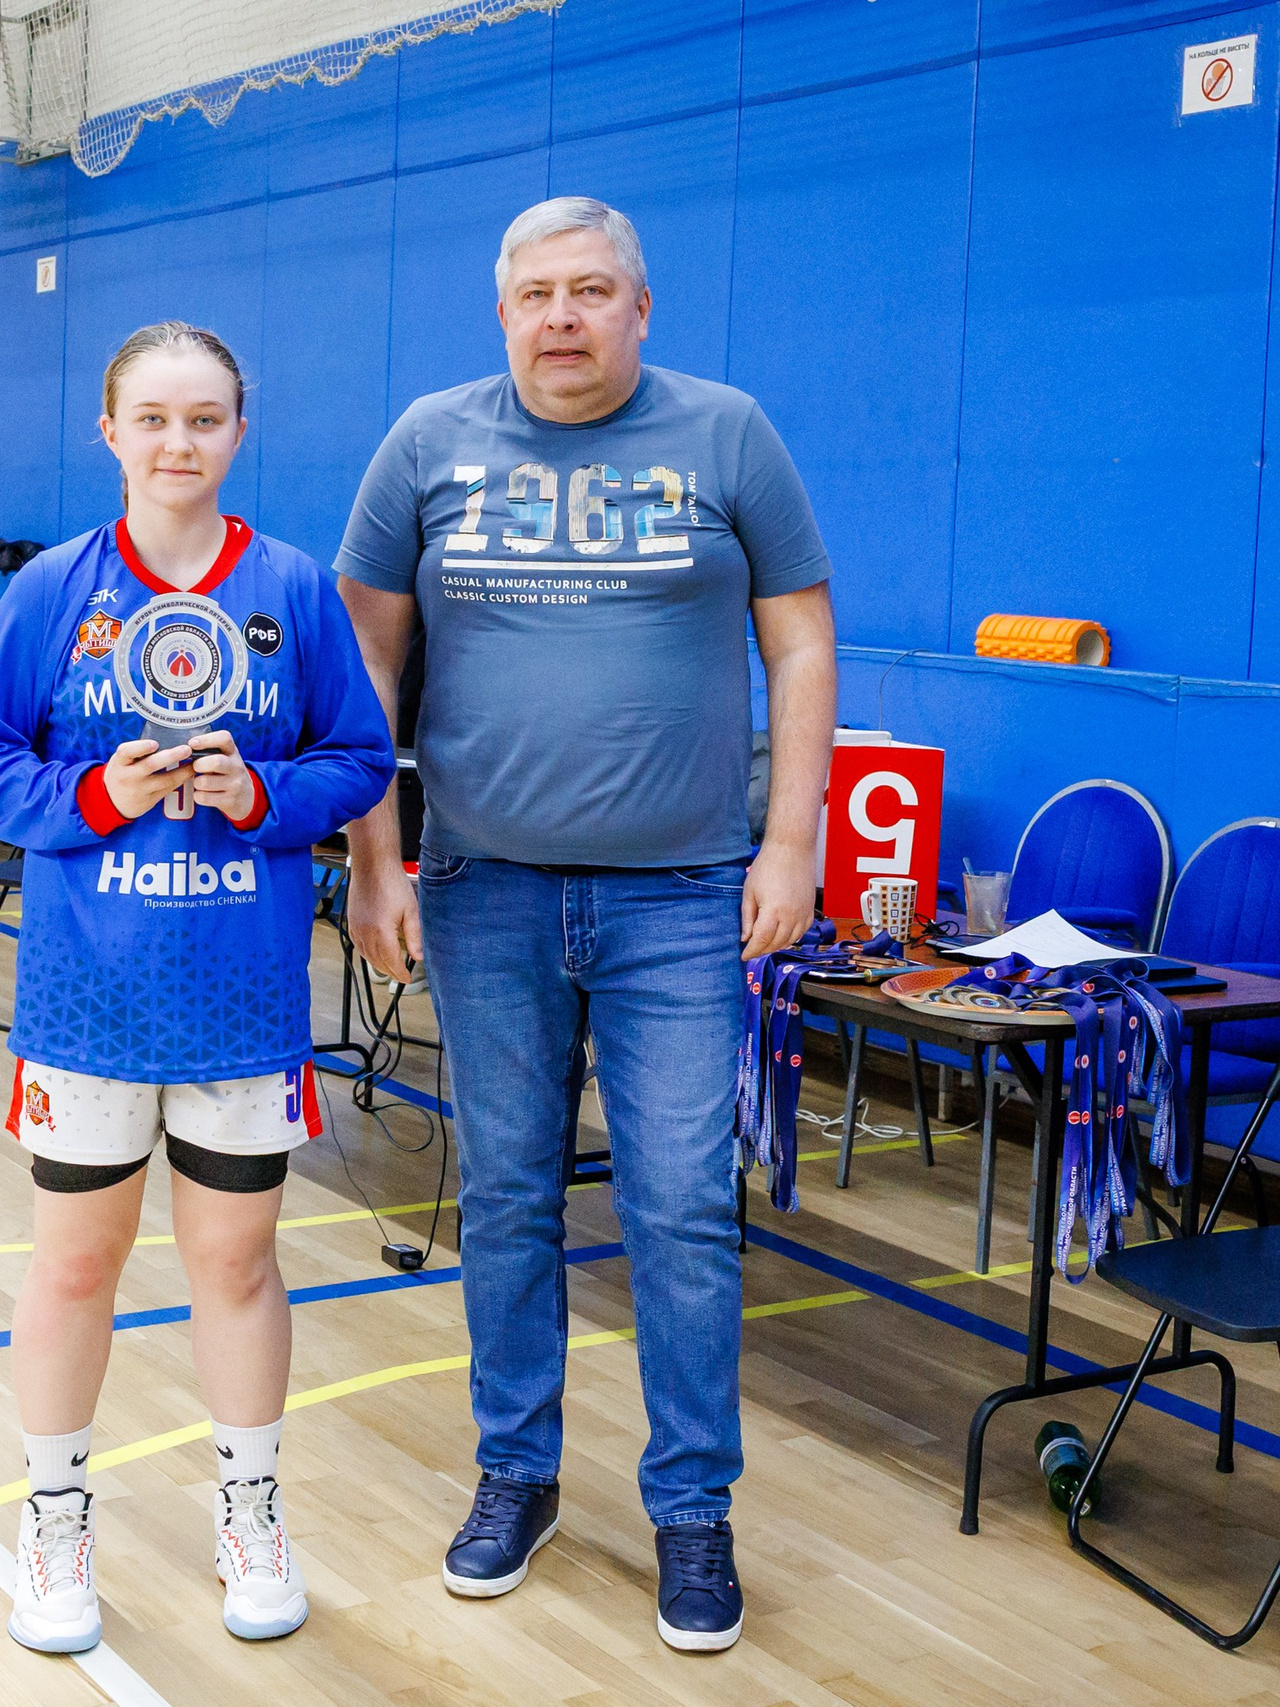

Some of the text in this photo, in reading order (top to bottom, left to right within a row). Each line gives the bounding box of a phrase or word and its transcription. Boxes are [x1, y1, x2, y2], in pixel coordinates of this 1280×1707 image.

[687, 471, 697, 493] TOM
[444, 462, 690, 556] 1962
[441, 575, 628, 591] CASUAL MANUFACTURING CLUB
[444, 589, 588, 605] CLASSIC CUSTOM DESIGN
[248, 627, 277, 641] РФБ
[848, 771, 918, 876] 5
[97, 851, 257, 897] Haiba
[144, 894, 257, 909] Производство CHENKAI
[1069, 1166, 1078, 1197] ОБЛАСТИ
